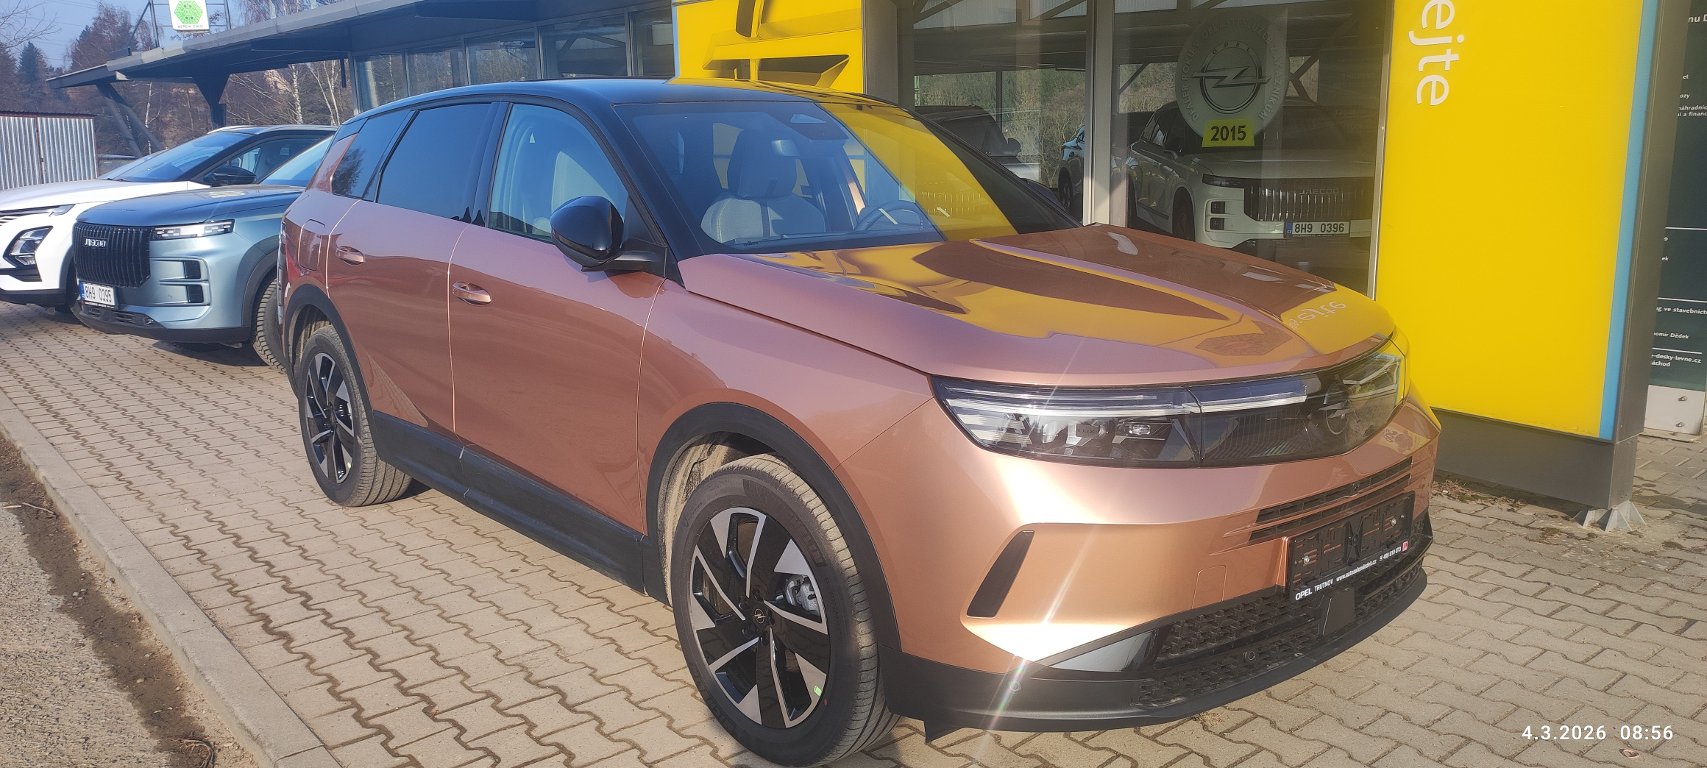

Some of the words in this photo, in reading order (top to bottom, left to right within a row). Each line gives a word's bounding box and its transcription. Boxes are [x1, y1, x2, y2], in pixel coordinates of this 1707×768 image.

[1408, 0, 1465, 106] ejte
[1210, 125, 1247, 142] 2015
[1294, 223, 1313, 233] 8H9
[1320, 223, 1345, 233] 0396
[1295, 588, 1313, 601] OPEL
[1314, 578, 1334, 592] TRUTNOV
